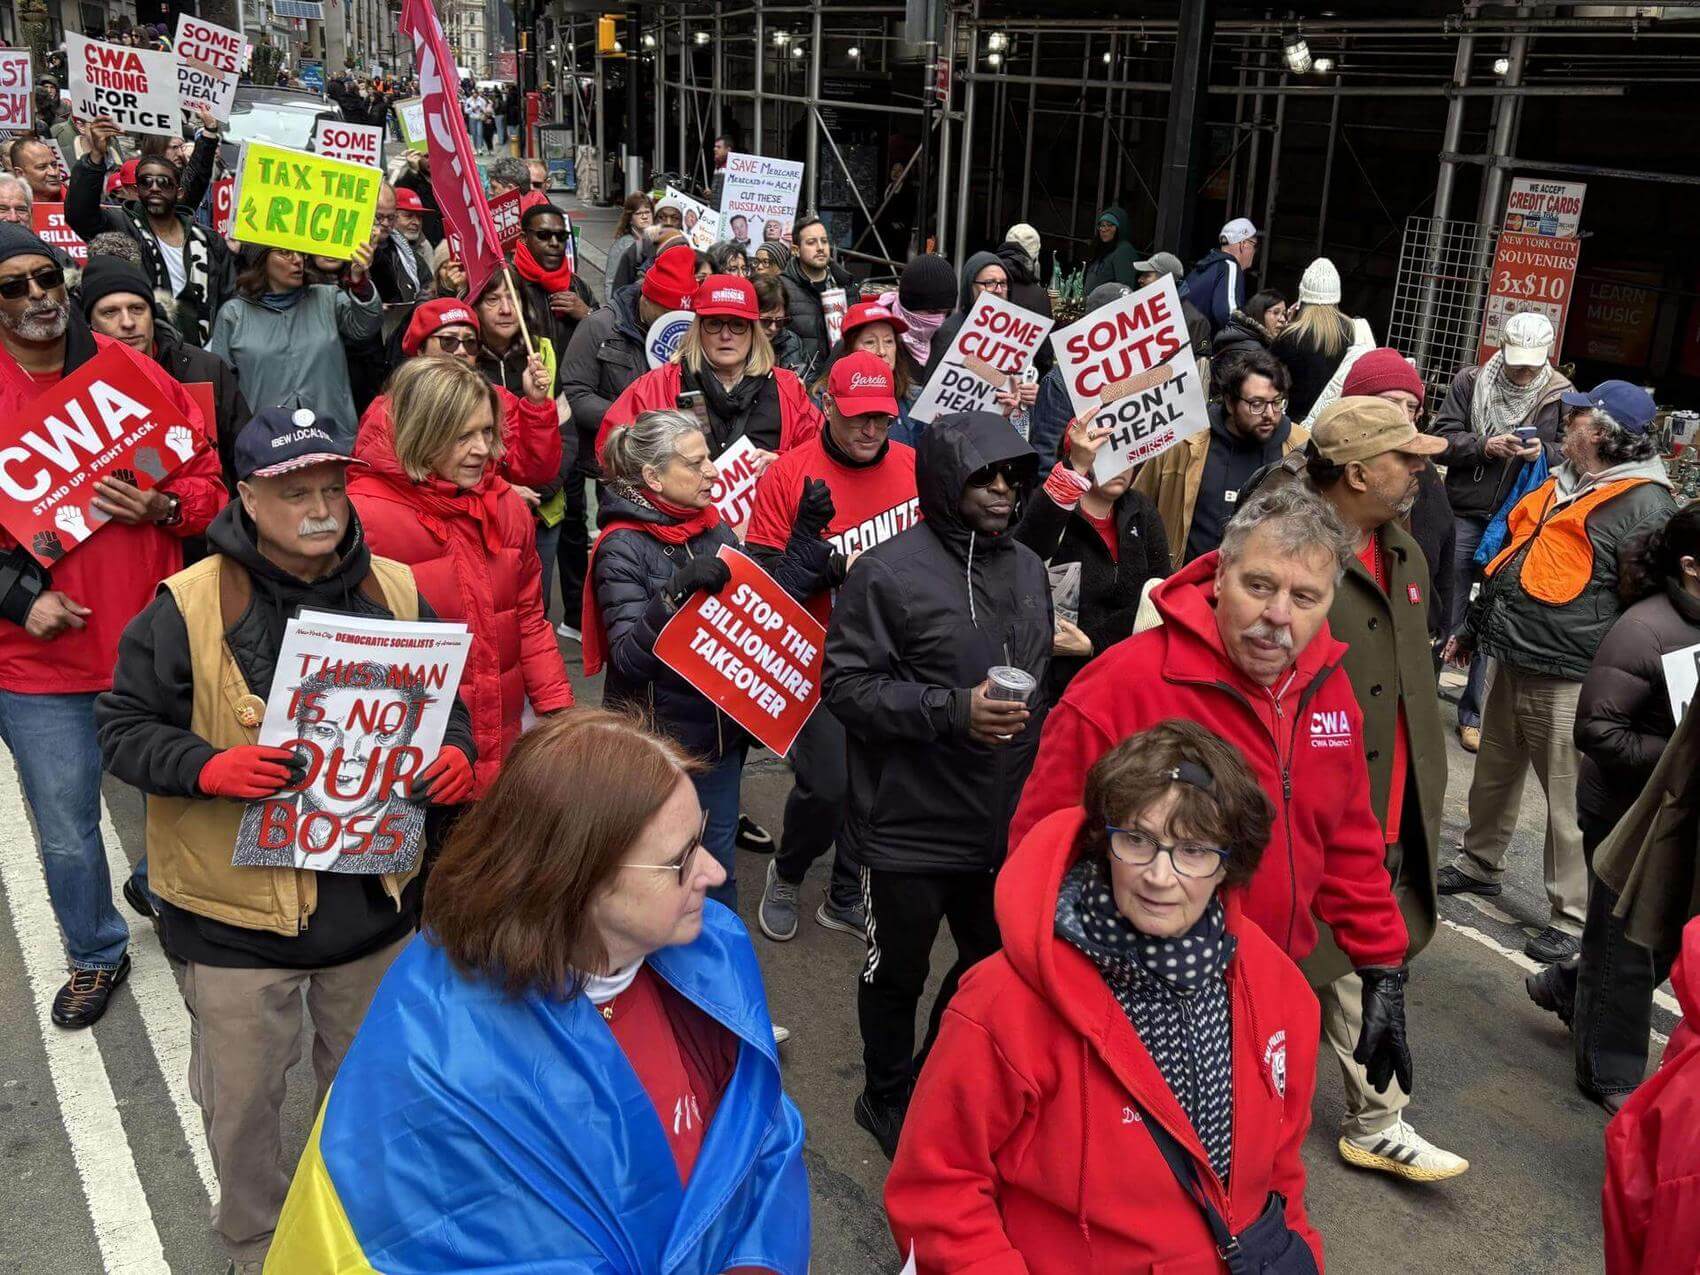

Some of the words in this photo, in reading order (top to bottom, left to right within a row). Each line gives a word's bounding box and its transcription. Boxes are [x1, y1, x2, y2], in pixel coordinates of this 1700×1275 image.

[183, 23, 241, 53] SOME
[84, 43, 146, 74] CWA
[178, 42, 236, 72] CUTS
[0, 59, 28, 87] ST
[86, 65, 149, 94] STRONG
[177, 68, 231, 93] DON'T
[94, 87, 138, 109] FOR
[179, 82, 220, 104] HEAL
[80, 99, 170, 129] JUSTICE
[322, 129, 377, 151] SOME
[258, 157, 312, 190] TAX
[321, 170, 370, 203] THE
[731, 159, 760, 173] SAVE
[740, 191, 755, 200] CUT
[757, 193, 782, 203] THESE
[1510, 191, 1546, 211] CREDIT
[1547, 195, 1581, 215] CARDS
[1529, 183, 1539, 192] WE
[1540, 185, 1566, 194] ACCEPT
[265, 196, 360, 247] RICH
[729, 200, 766, 212] RUSSIAN
[767, 206, 794, 216] ASSETS
[1503, 235, 1525, 245] NEW
[1526, 238, 1551, 249] YORK
[1553, 241, 1577, 251] CITY
[1498, 249, 1577, 271] SOUVENIRS
[1496, 270, 1565, 300] 3x$10
[1588, 283, 1648, 304] LEARN
[974, 305, 1044, 348] SOME
[1066, 292, 1172, 365] SOME
[1587, 304, 1645, 326] MUSIC
[958, 331, 1029, 375] CUTS
[1074, 325, 1180, 398] CUTS
[1095, 372, 1188, 428] DON'T
[0, 379, 152, 502] CWA
[1109, 403, 1184, 452] HEAL
[32, 484, 70, 516] STAND
[71, 471, 91, 487] UP.
[90, 444, 124, 473] FIGHT
[124, 422, 158, 446] BACK.
[709, 449, 756, 504] OME
[720, 488, 757, 528] UT
[335, 632, 389, 647] DEMOCRATIC
[389, 637, 435, 649] SOCIALISTS
[731, 584, 784, 631] STOP
[780, 625, 817, 668] THE
[697, 595, 814, 702] BILLIONAIRE
[296, 653, 374, 687] THIS
[385, 662, 450, 690] MAN
[689, 627, 787, 719] TAKEOVER
[286, 686, 329, 724] IS
[345, 698, 440, 735] NOT
[1310, 711, 1350, 733] CWA
[280, 739, 424, 801] OUR
[257, 802, 408, 855] BOSS
[1122, 1106, 1142, 1124] De
